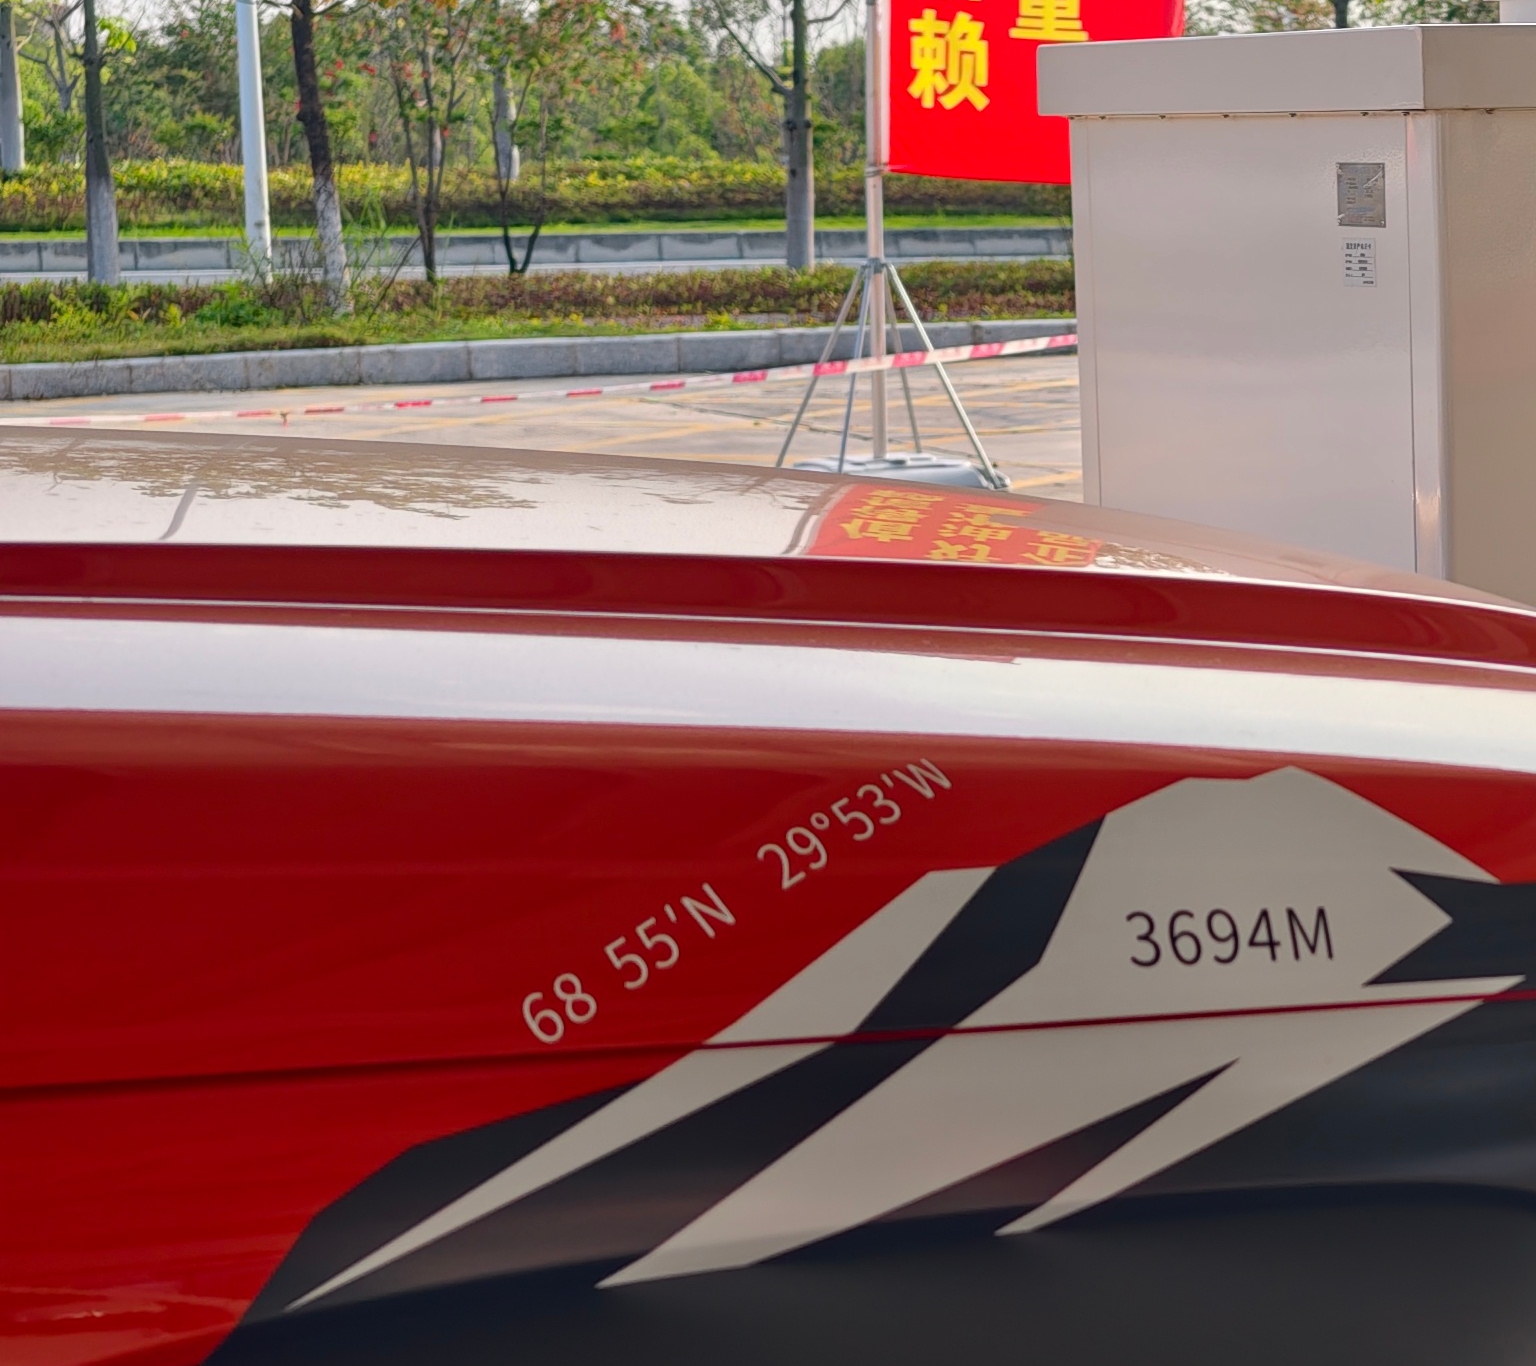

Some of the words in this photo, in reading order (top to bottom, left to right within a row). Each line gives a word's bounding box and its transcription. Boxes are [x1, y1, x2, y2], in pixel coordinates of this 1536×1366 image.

[521, 972, 598, 1045] 68
[603, 881, 737, 990] 55'N
[1125, 905, 1335, 968] 3694M
